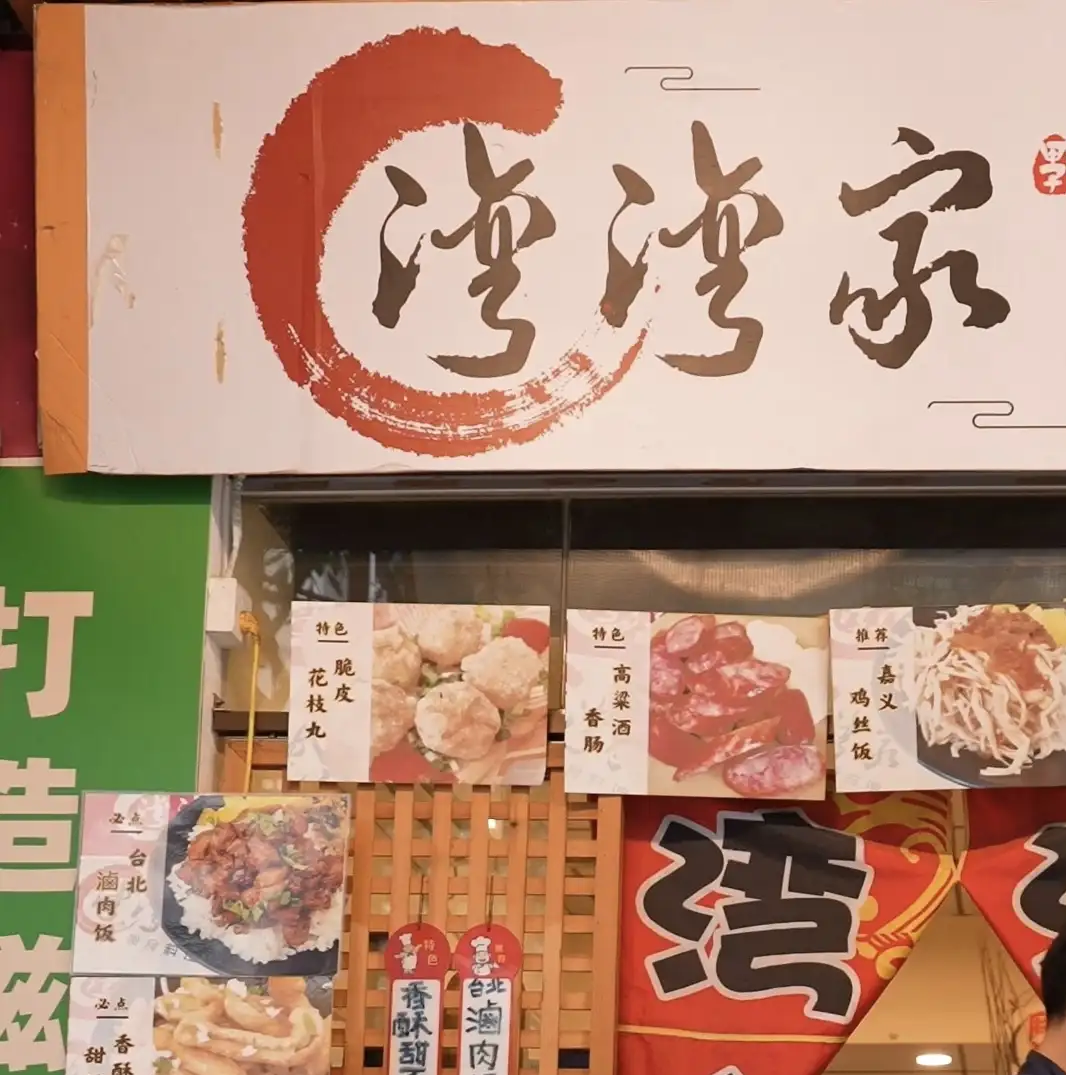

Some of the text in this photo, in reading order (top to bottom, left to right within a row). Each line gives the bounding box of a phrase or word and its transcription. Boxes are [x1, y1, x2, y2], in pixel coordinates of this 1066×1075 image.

[316, 620, 349, 636] 特色
[592, 626, 626, 642] 特色
[855, 627, 890, 643] 推荐
[305, 668, 328, 738] 花枝丸
[334, 658, 355, 703] 脆皮
[877, 664, 898, 711] 嘉义
[584, 708, 605, 753] 香肠
[850, 688, 873, 760] 鸡丝饭
[126, 849, 147, 894] 台北
[95, 997, 128, 1011] 必点
[467, 978, 508, 998] 台北
